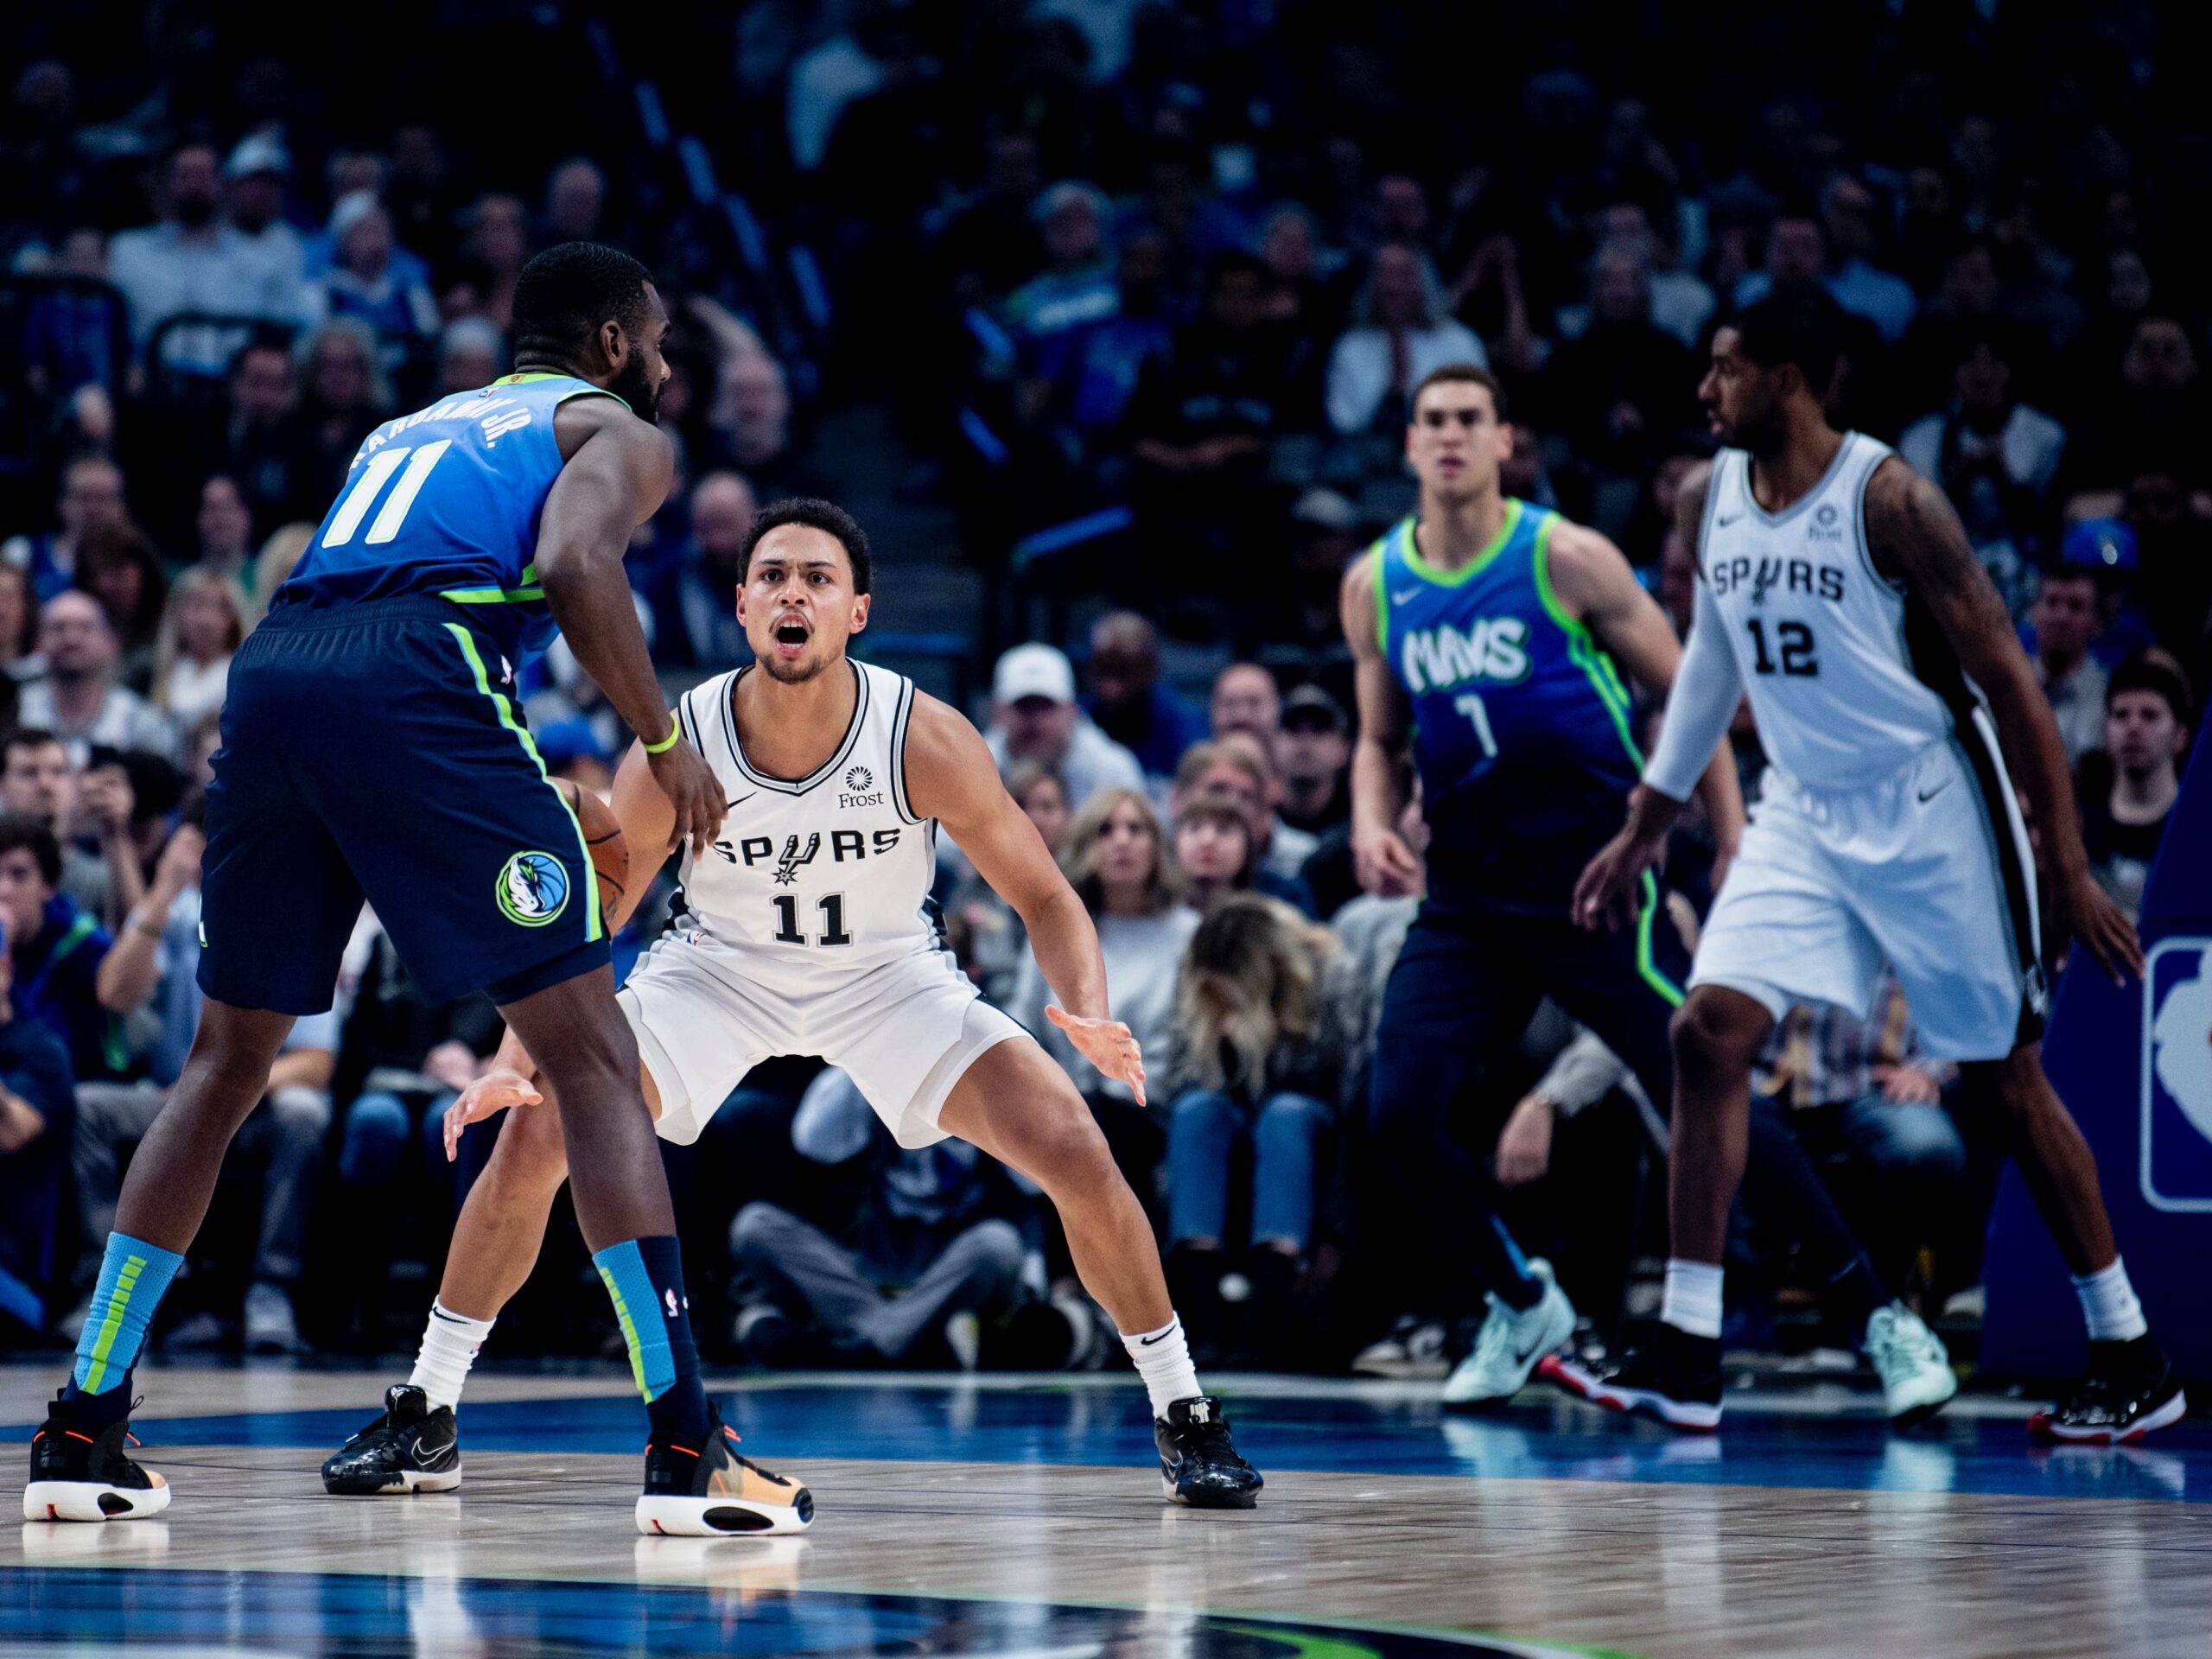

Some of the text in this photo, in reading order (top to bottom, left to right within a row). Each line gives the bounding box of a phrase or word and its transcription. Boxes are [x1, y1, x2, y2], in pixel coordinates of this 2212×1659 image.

[321, 439, 452, 549] 11
[1713, 556, 1845, 607] SPURS
[1402, 616, 1529, 694] MAVS
[1747, 618, 1819, 677] 12
[837, 790, 885, 809] Frost
[714, 828, 901, 886] SPURS
[769, 891, 854, 948] 11
